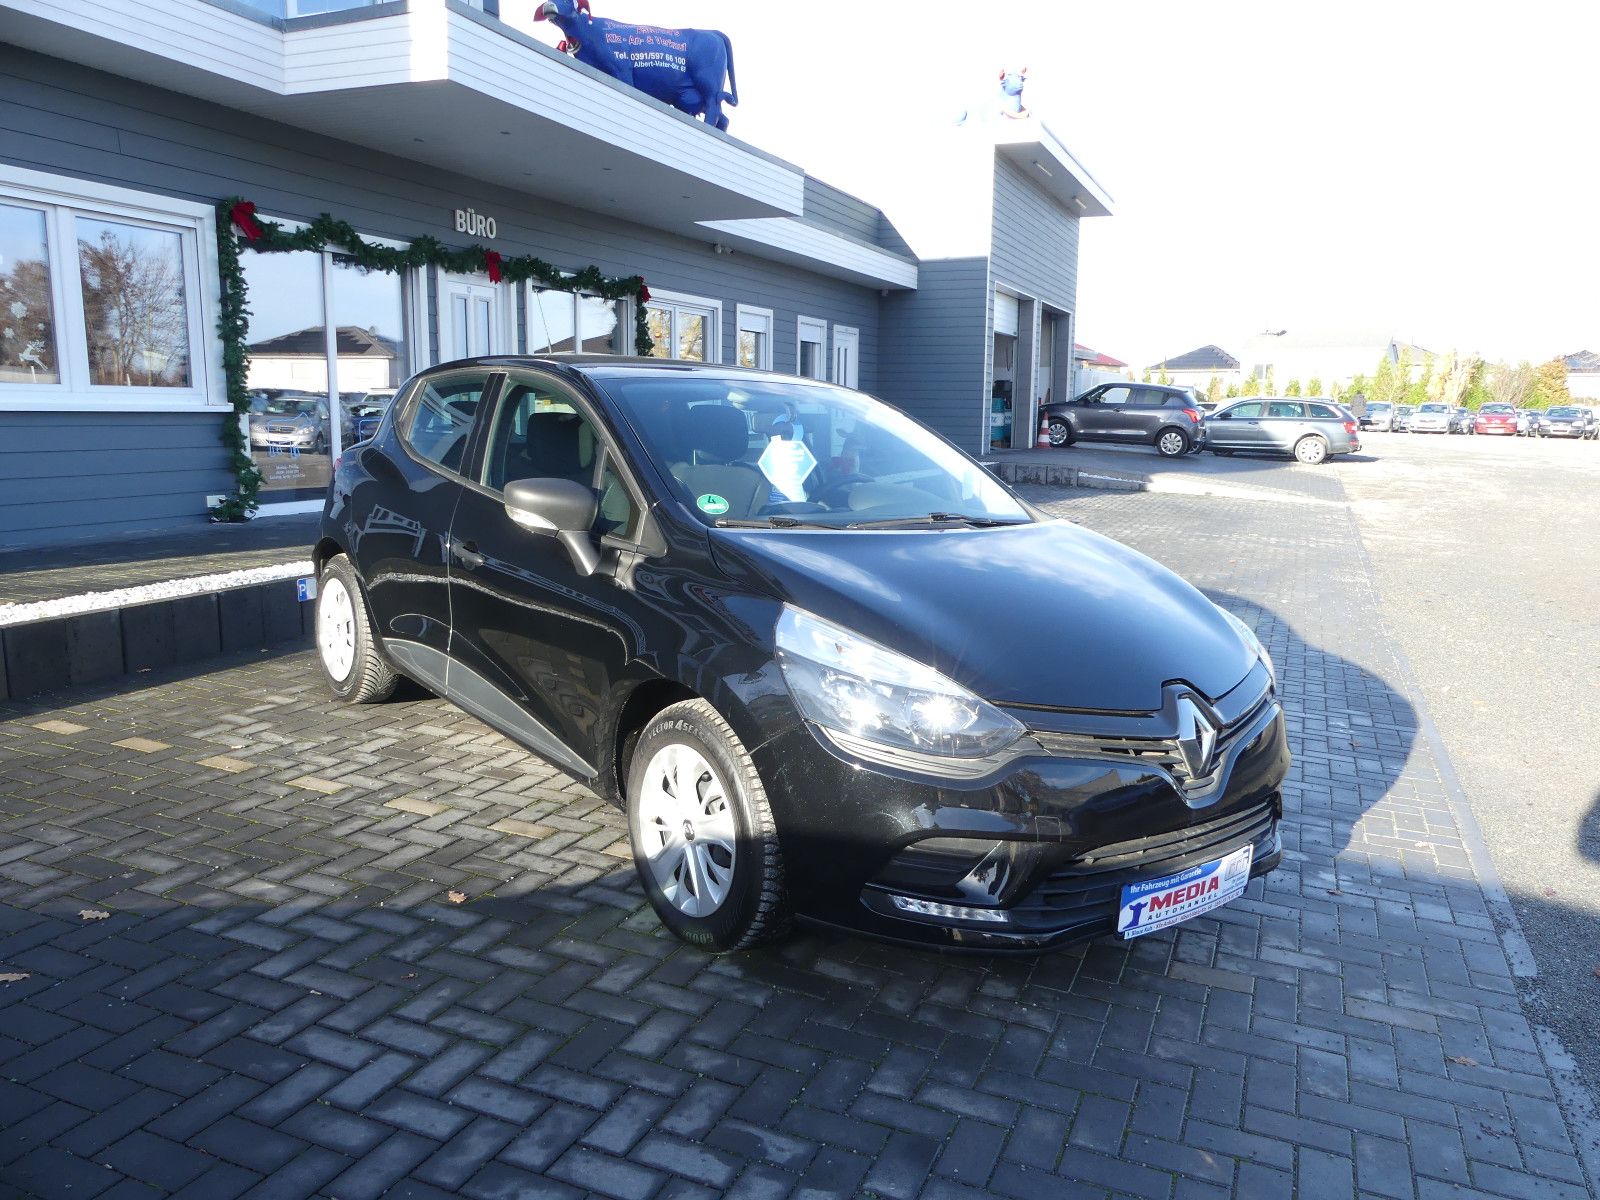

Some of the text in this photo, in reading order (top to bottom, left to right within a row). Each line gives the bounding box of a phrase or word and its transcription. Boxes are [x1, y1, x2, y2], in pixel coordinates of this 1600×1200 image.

[614, 51, 629, 60] Tel.
[674, 56, 686, 65] 100
[455, 208, 497, 239] BÜRO
[648, 720, 674, 739] VECTOR
[1130, 885, 1140, 894] Ihr
[1141, 879, 1170, 892] Fahrzeug
[1170, 876, 1180, 884] mit
[1149, 876, 1219, 912] MEDIA
[1147, 892, 1218, 921] AUTOHANDEL
